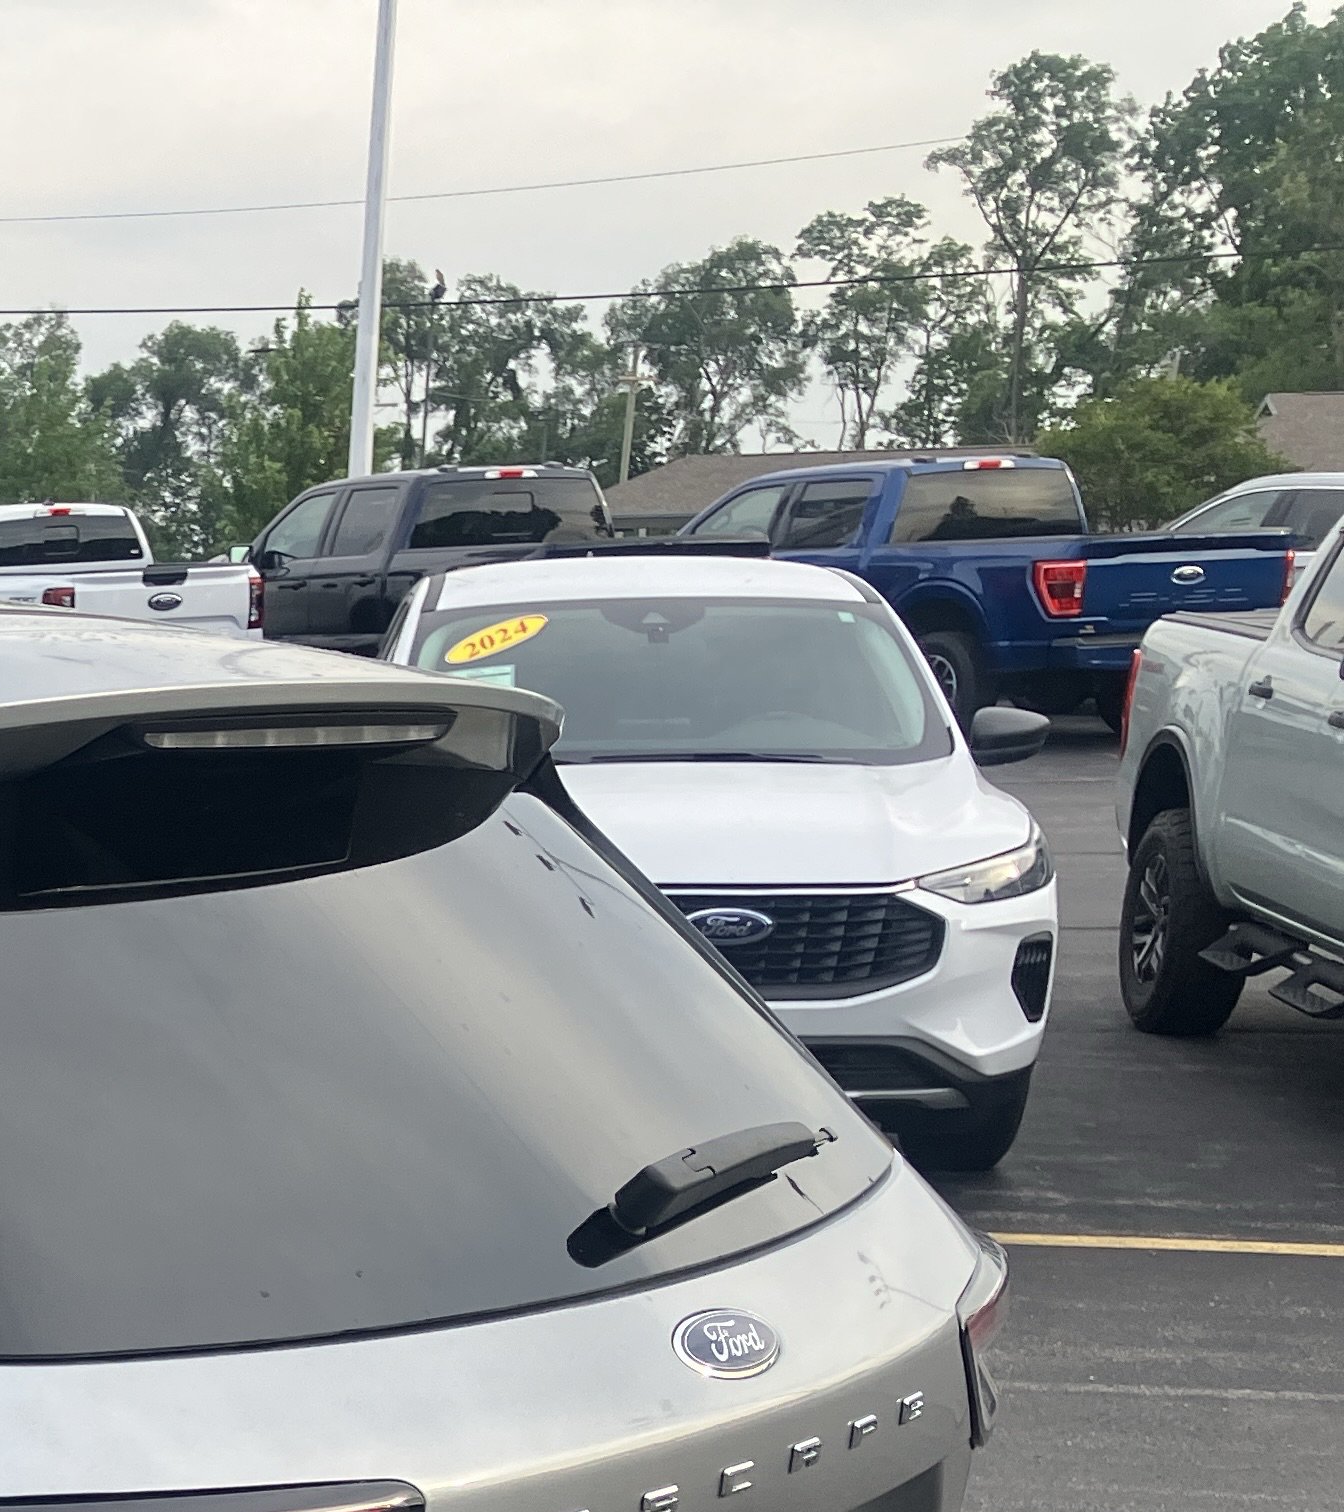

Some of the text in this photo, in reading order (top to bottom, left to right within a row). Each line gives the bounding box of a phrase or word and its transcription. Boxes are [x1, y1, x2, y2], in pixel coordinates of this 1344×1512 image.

[464, 620, 529, 658] 2024
[702, 915, 752, 937] Ford
[703, 1319, 765, 1362] Ford
